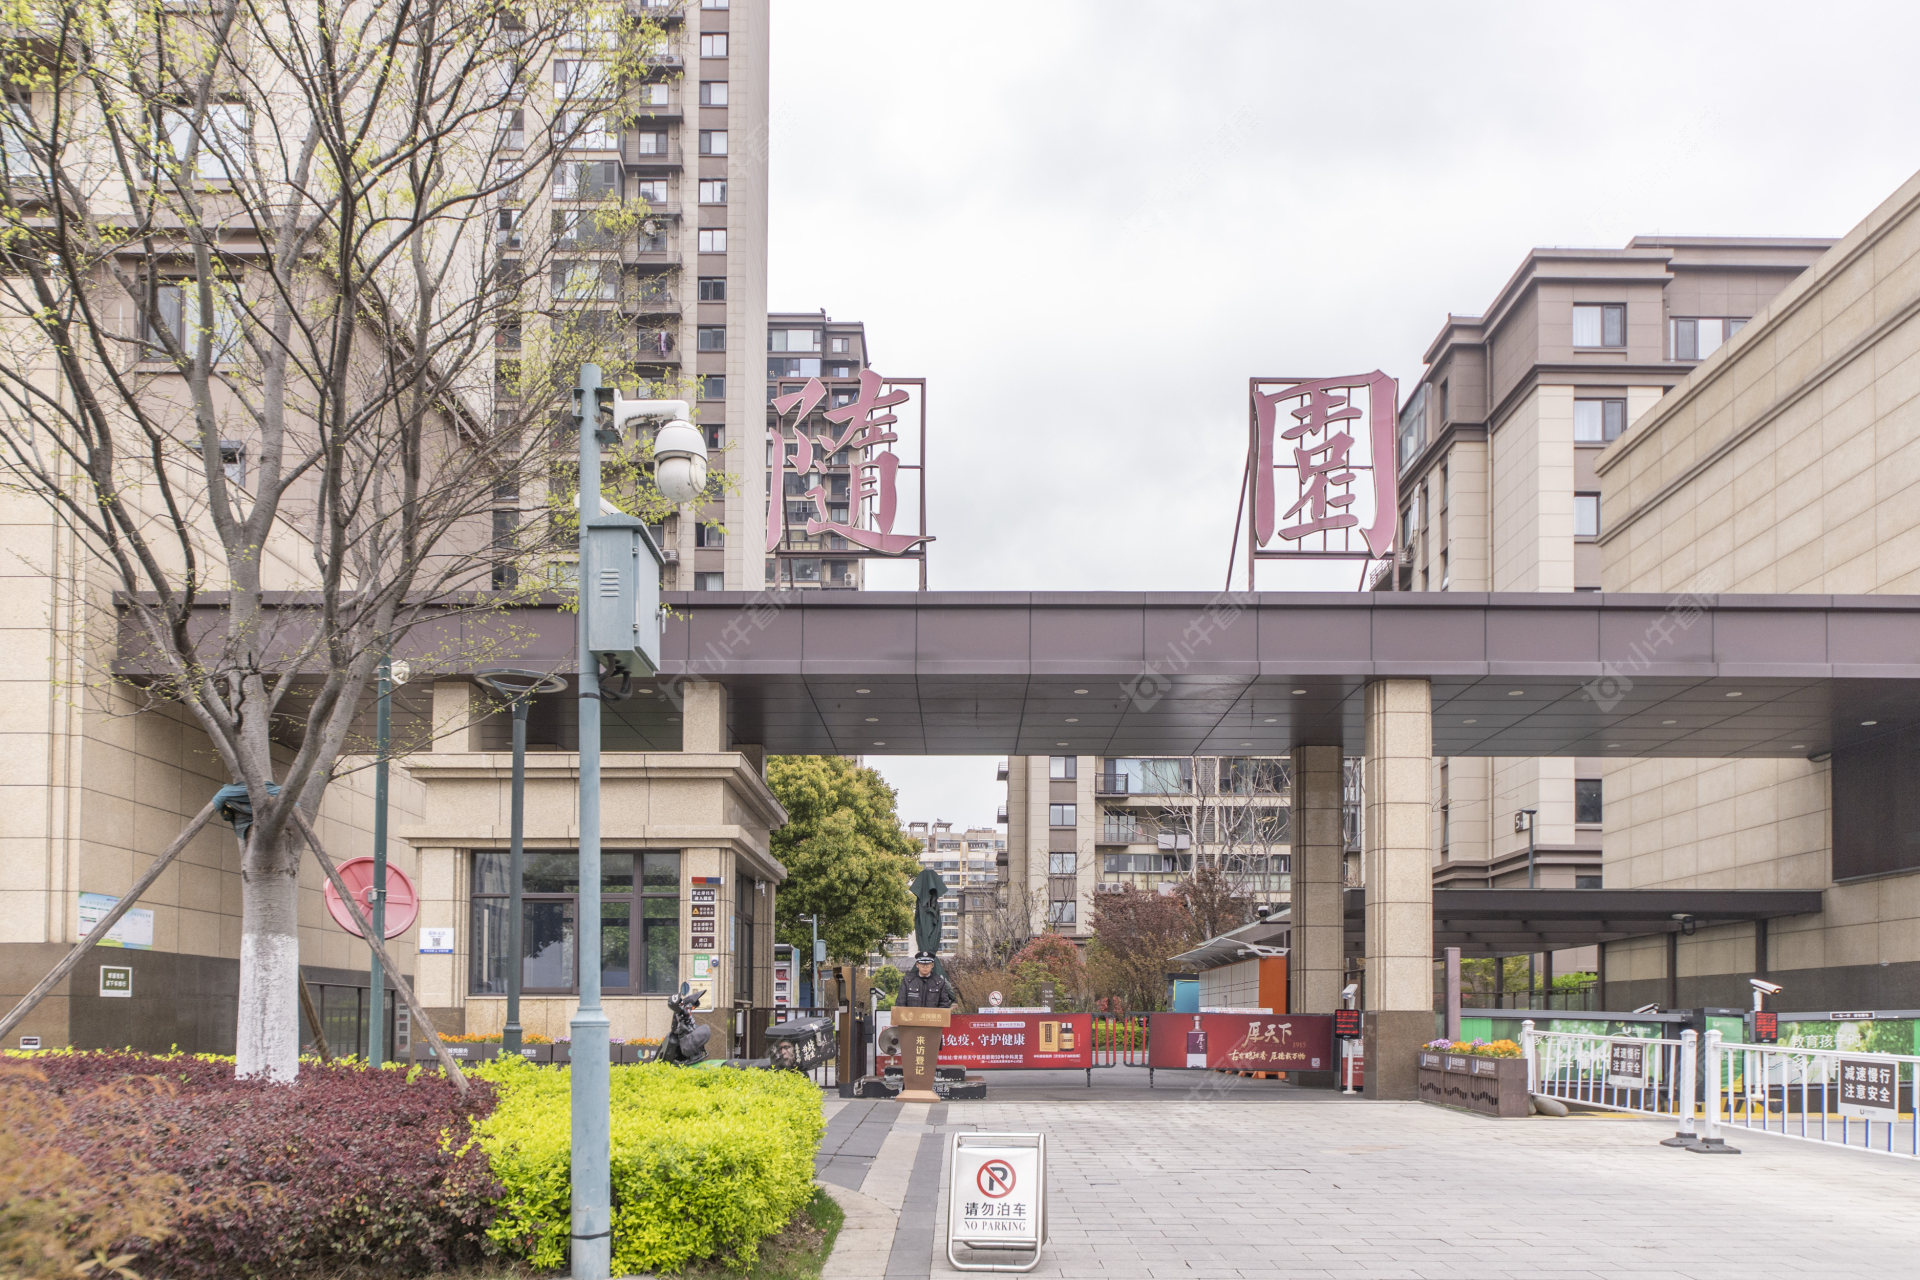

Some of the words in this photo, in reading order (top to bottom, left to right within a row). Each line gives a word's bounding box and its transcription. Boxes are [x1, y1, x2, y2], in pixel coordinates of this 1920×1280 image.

[915, 1036, 926, 1076] 来访登记
[1613, 1047, 1641, 1061] 减速慢行
[1612, 1060, 1641, 1074] 注意安全
[1844, 1066, 1891, 1084] 减速慢行
[1844, 1084, 1891, 1103] 注意安全
[965, 1202, 1026, 1217] 请勿泊车
[964, 1221, 978, 1231] NO
[982, 1221, 1026, 1232] PARKING
